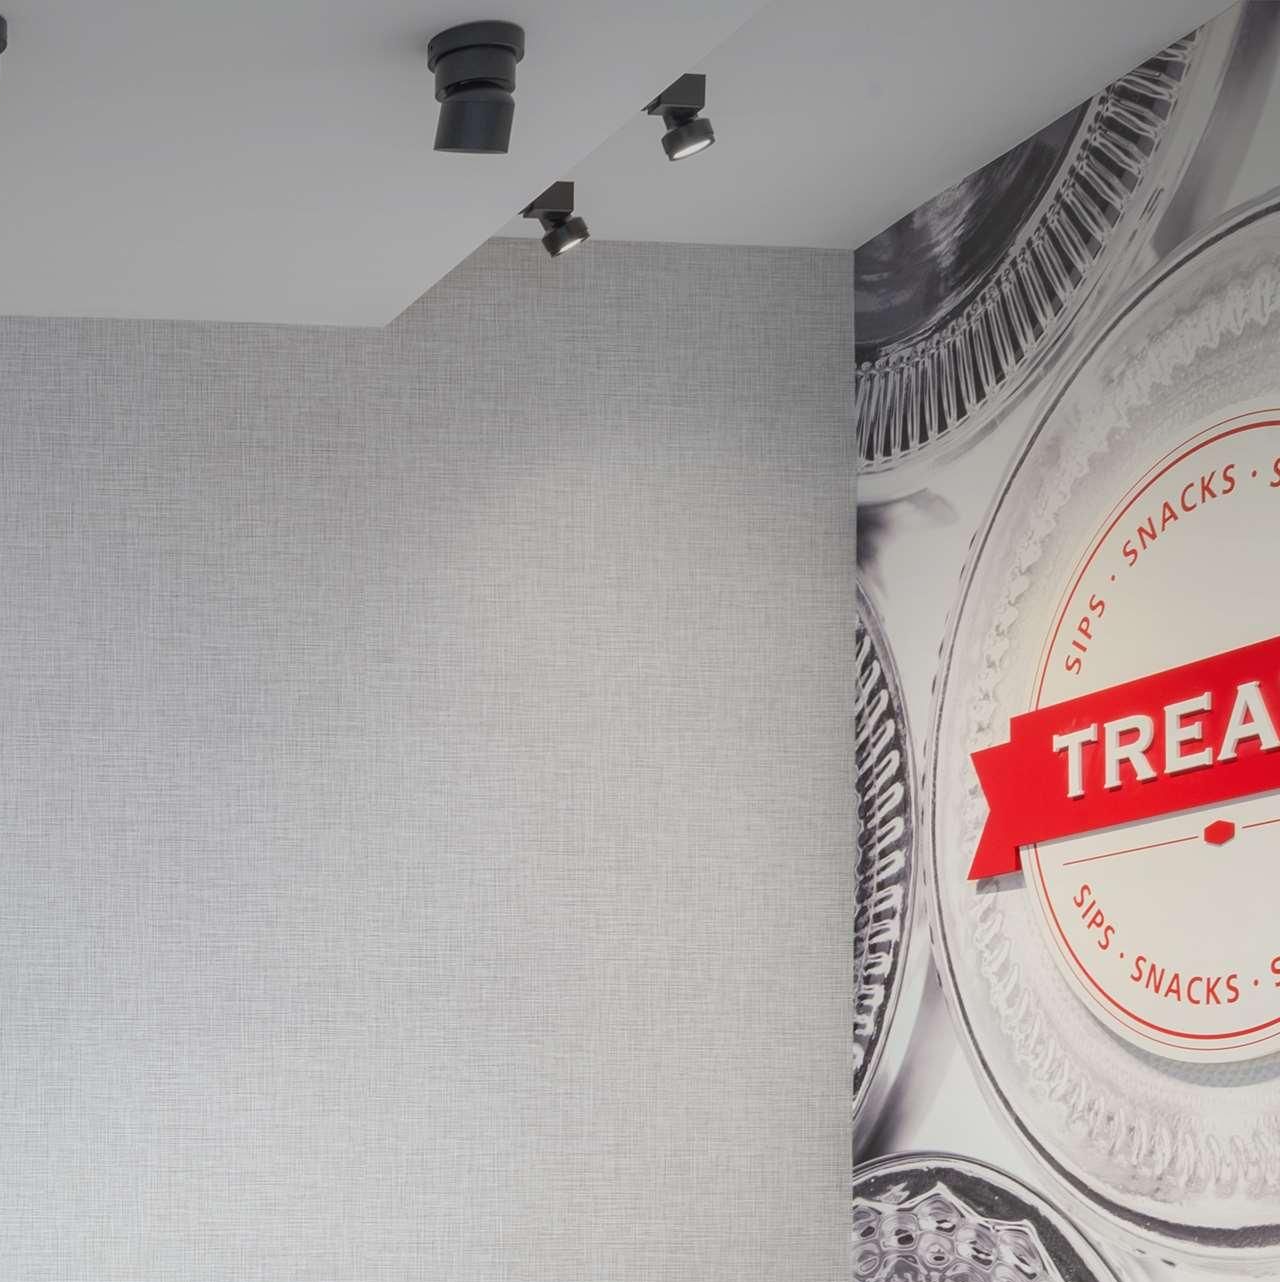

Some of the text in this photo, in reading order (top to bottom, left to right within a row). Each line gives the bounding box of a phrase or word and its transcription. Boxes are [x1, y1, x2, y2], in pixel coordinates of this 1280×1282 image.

[1064, 461, 1238, 677] SIPS SNACKS
[1072, 881, 1116, 952] SIPS
[1129, 953, 1241, 1007] SNACKS
